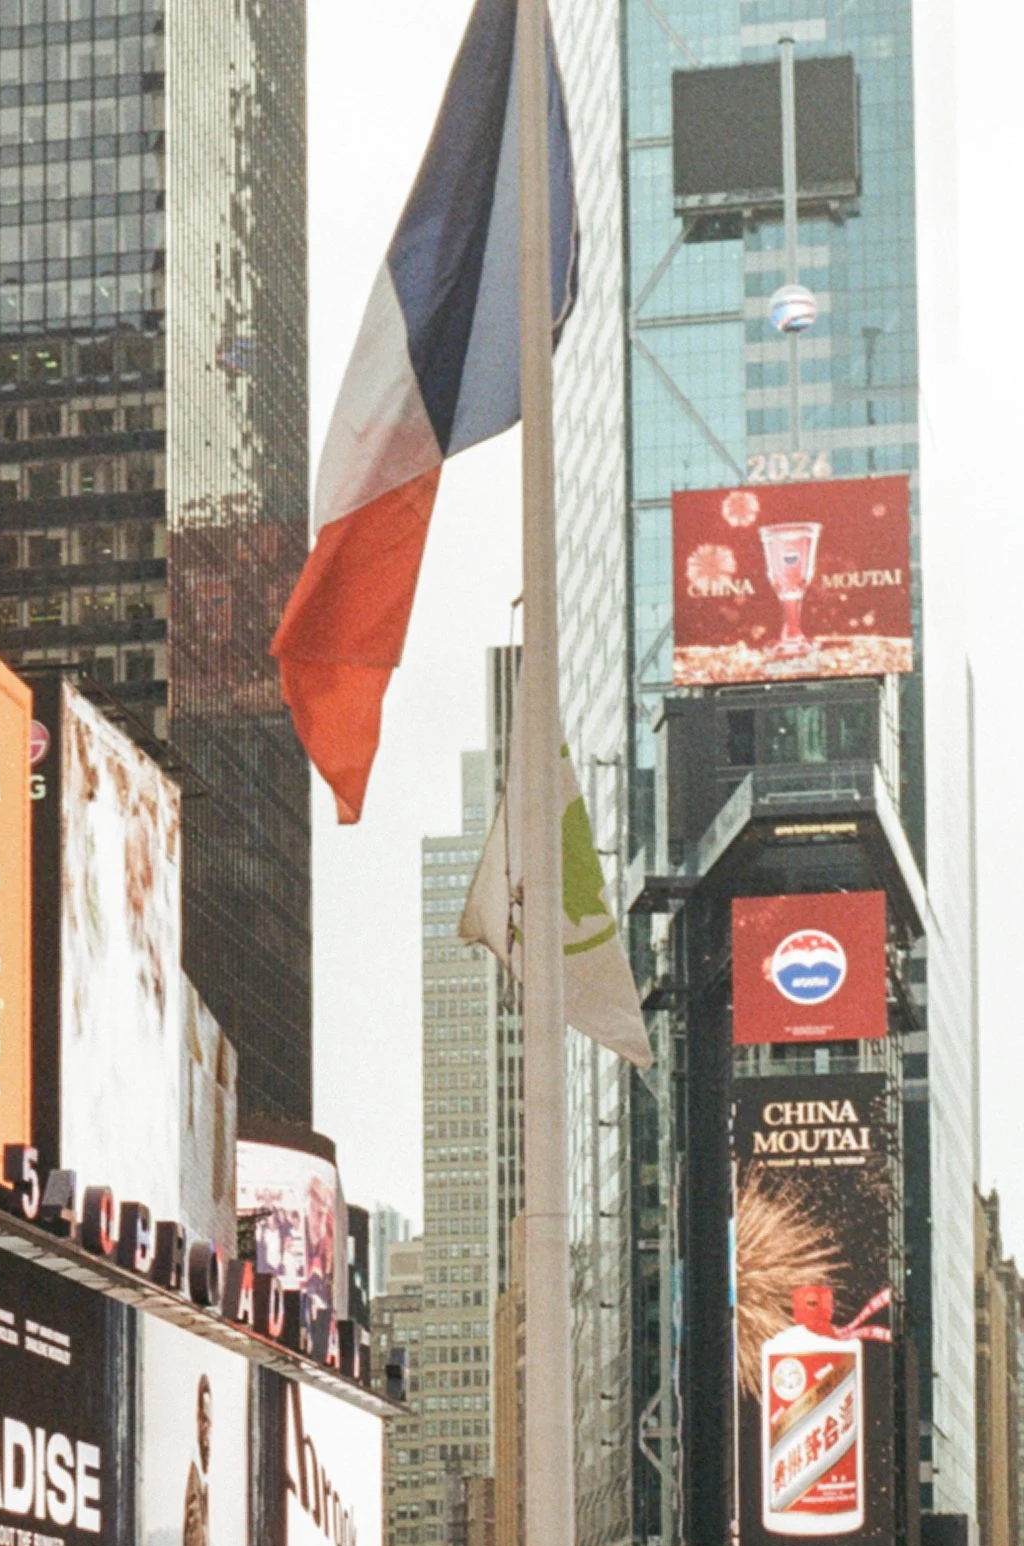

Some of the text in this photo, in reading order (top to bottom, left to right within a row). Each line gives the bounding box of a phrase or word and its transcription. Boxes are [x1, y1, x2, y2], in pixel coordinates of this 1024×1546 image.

[746, 451, 833, 482] 2026
[687, 568, 902, 598] CHINA MOUTAI
[763, 1099, 859, 1126] CHINA
[753, 1127, 870, 1154] MOUTAI
